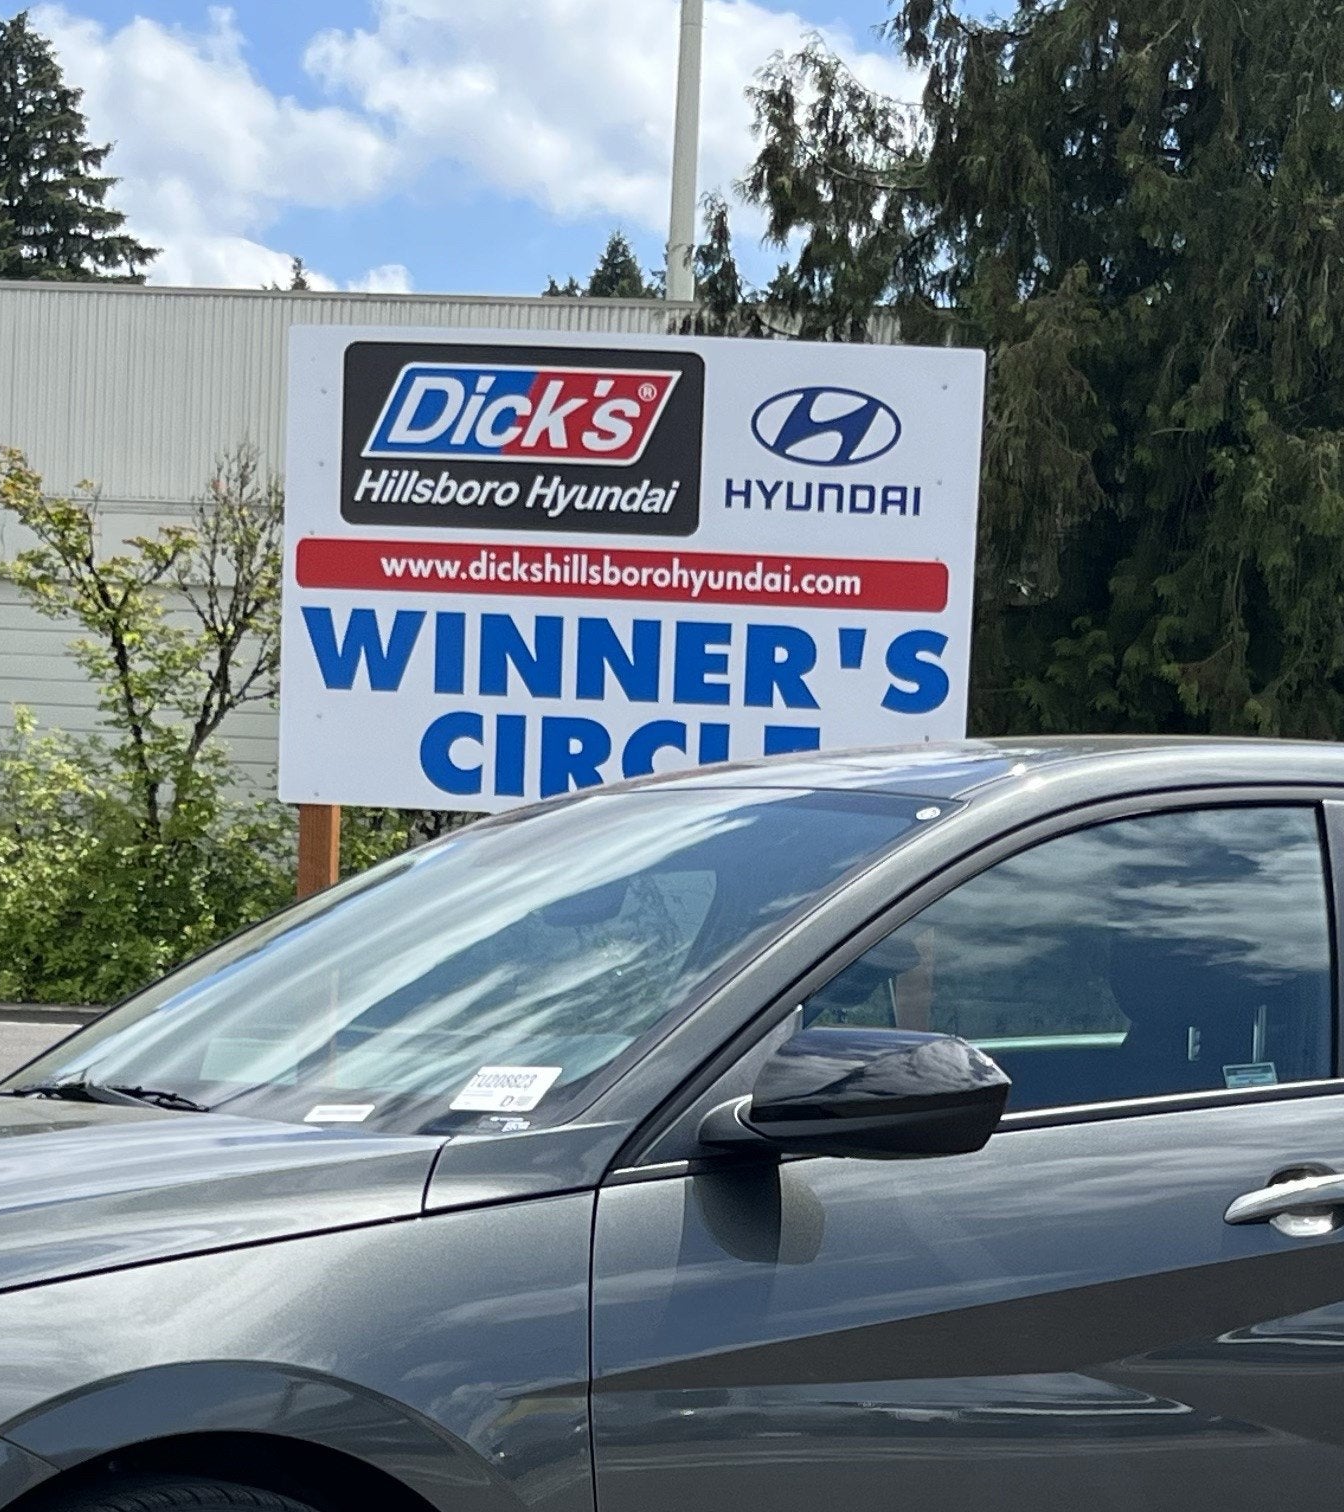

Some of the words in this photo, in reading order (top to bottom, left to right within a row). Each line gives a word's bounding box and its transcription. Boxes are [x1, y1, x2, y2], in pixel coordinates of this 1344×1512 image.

[354, 468, 520, 507] Hillsboro
[525, 475, 681, 519] Hyundai
[724, 477, 922, 517] HYUNDAI
[380, 551, 862, 597] www.dickshillsborohyundai.com
[301, 606, 950, 715] WINNER'S
